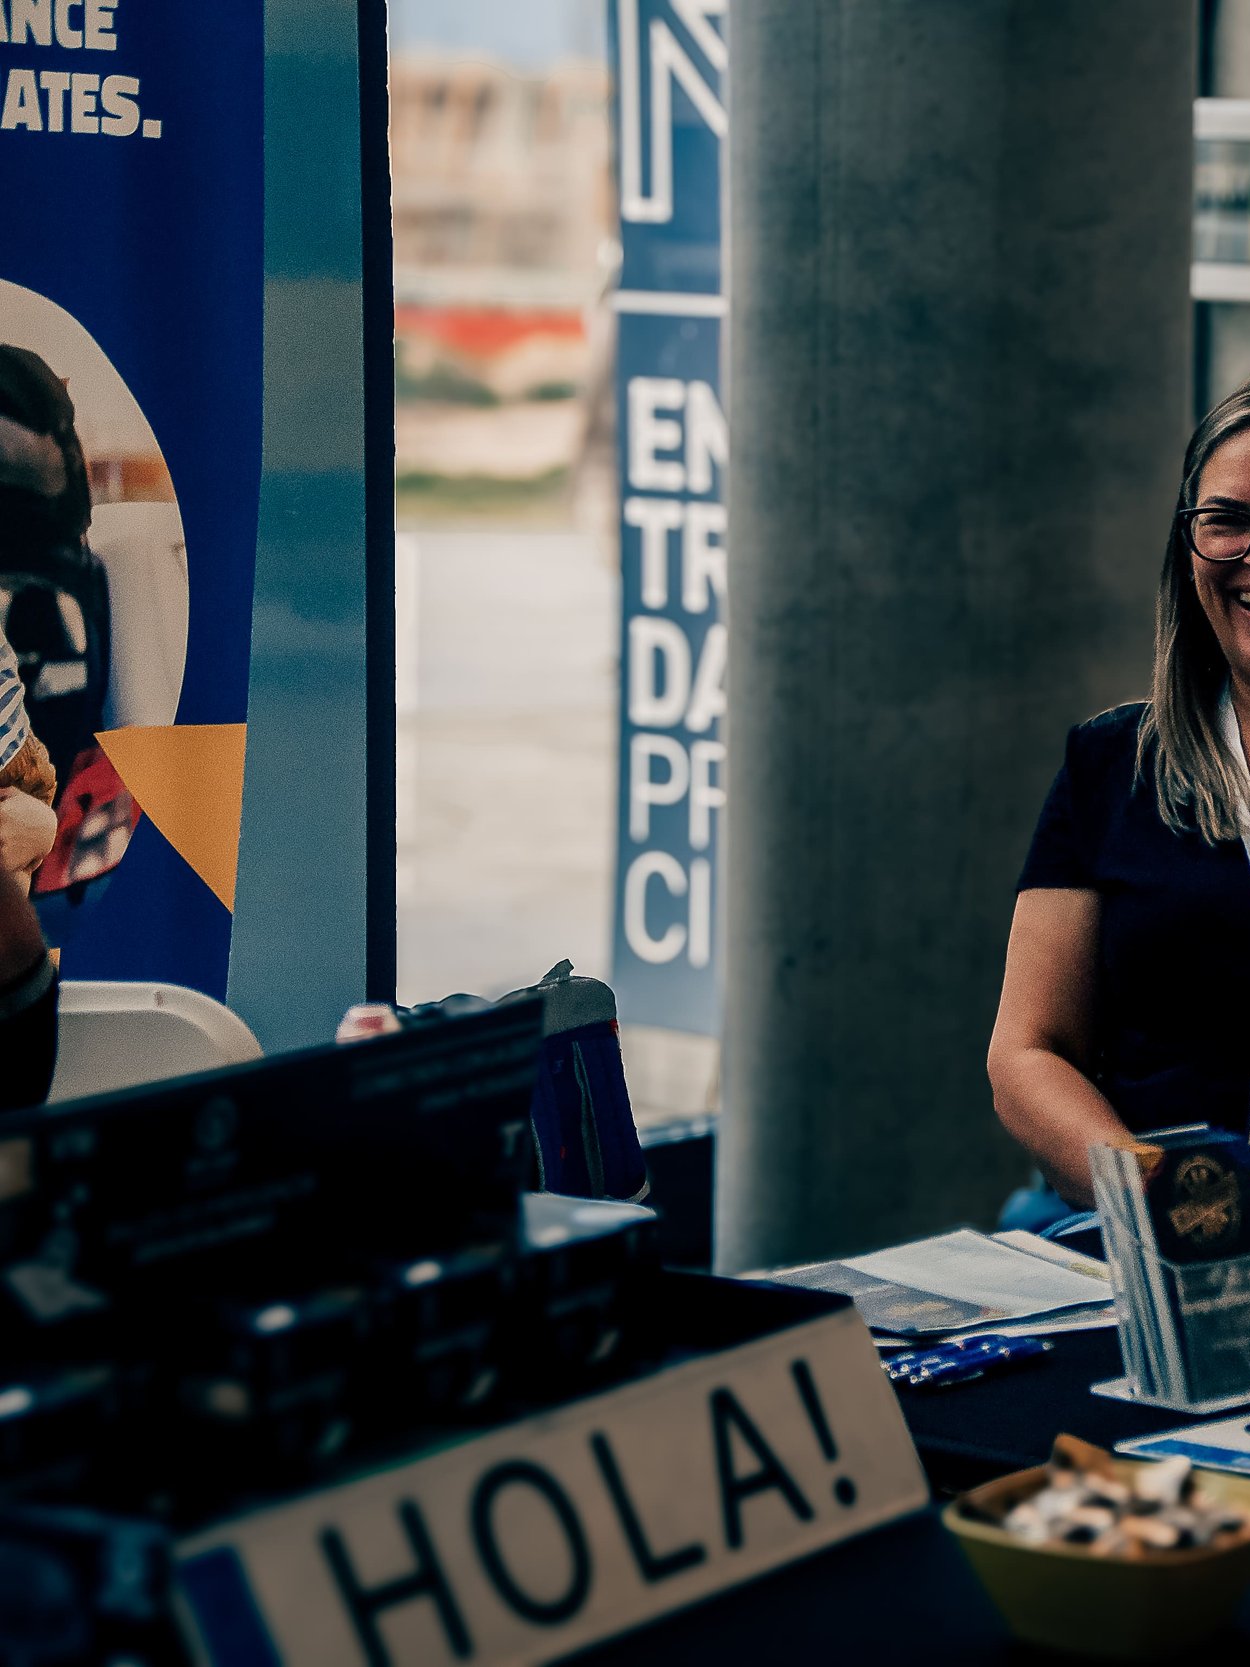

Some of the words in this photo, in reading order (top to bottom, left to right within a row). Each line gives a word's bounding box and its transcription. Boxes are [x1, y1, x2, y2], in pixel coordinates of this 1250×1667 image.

[0, 0, 119, 51] NCE
[0, 68, 162, 139] ATES.
[316, 1357, 859, 1667] HOLA!
